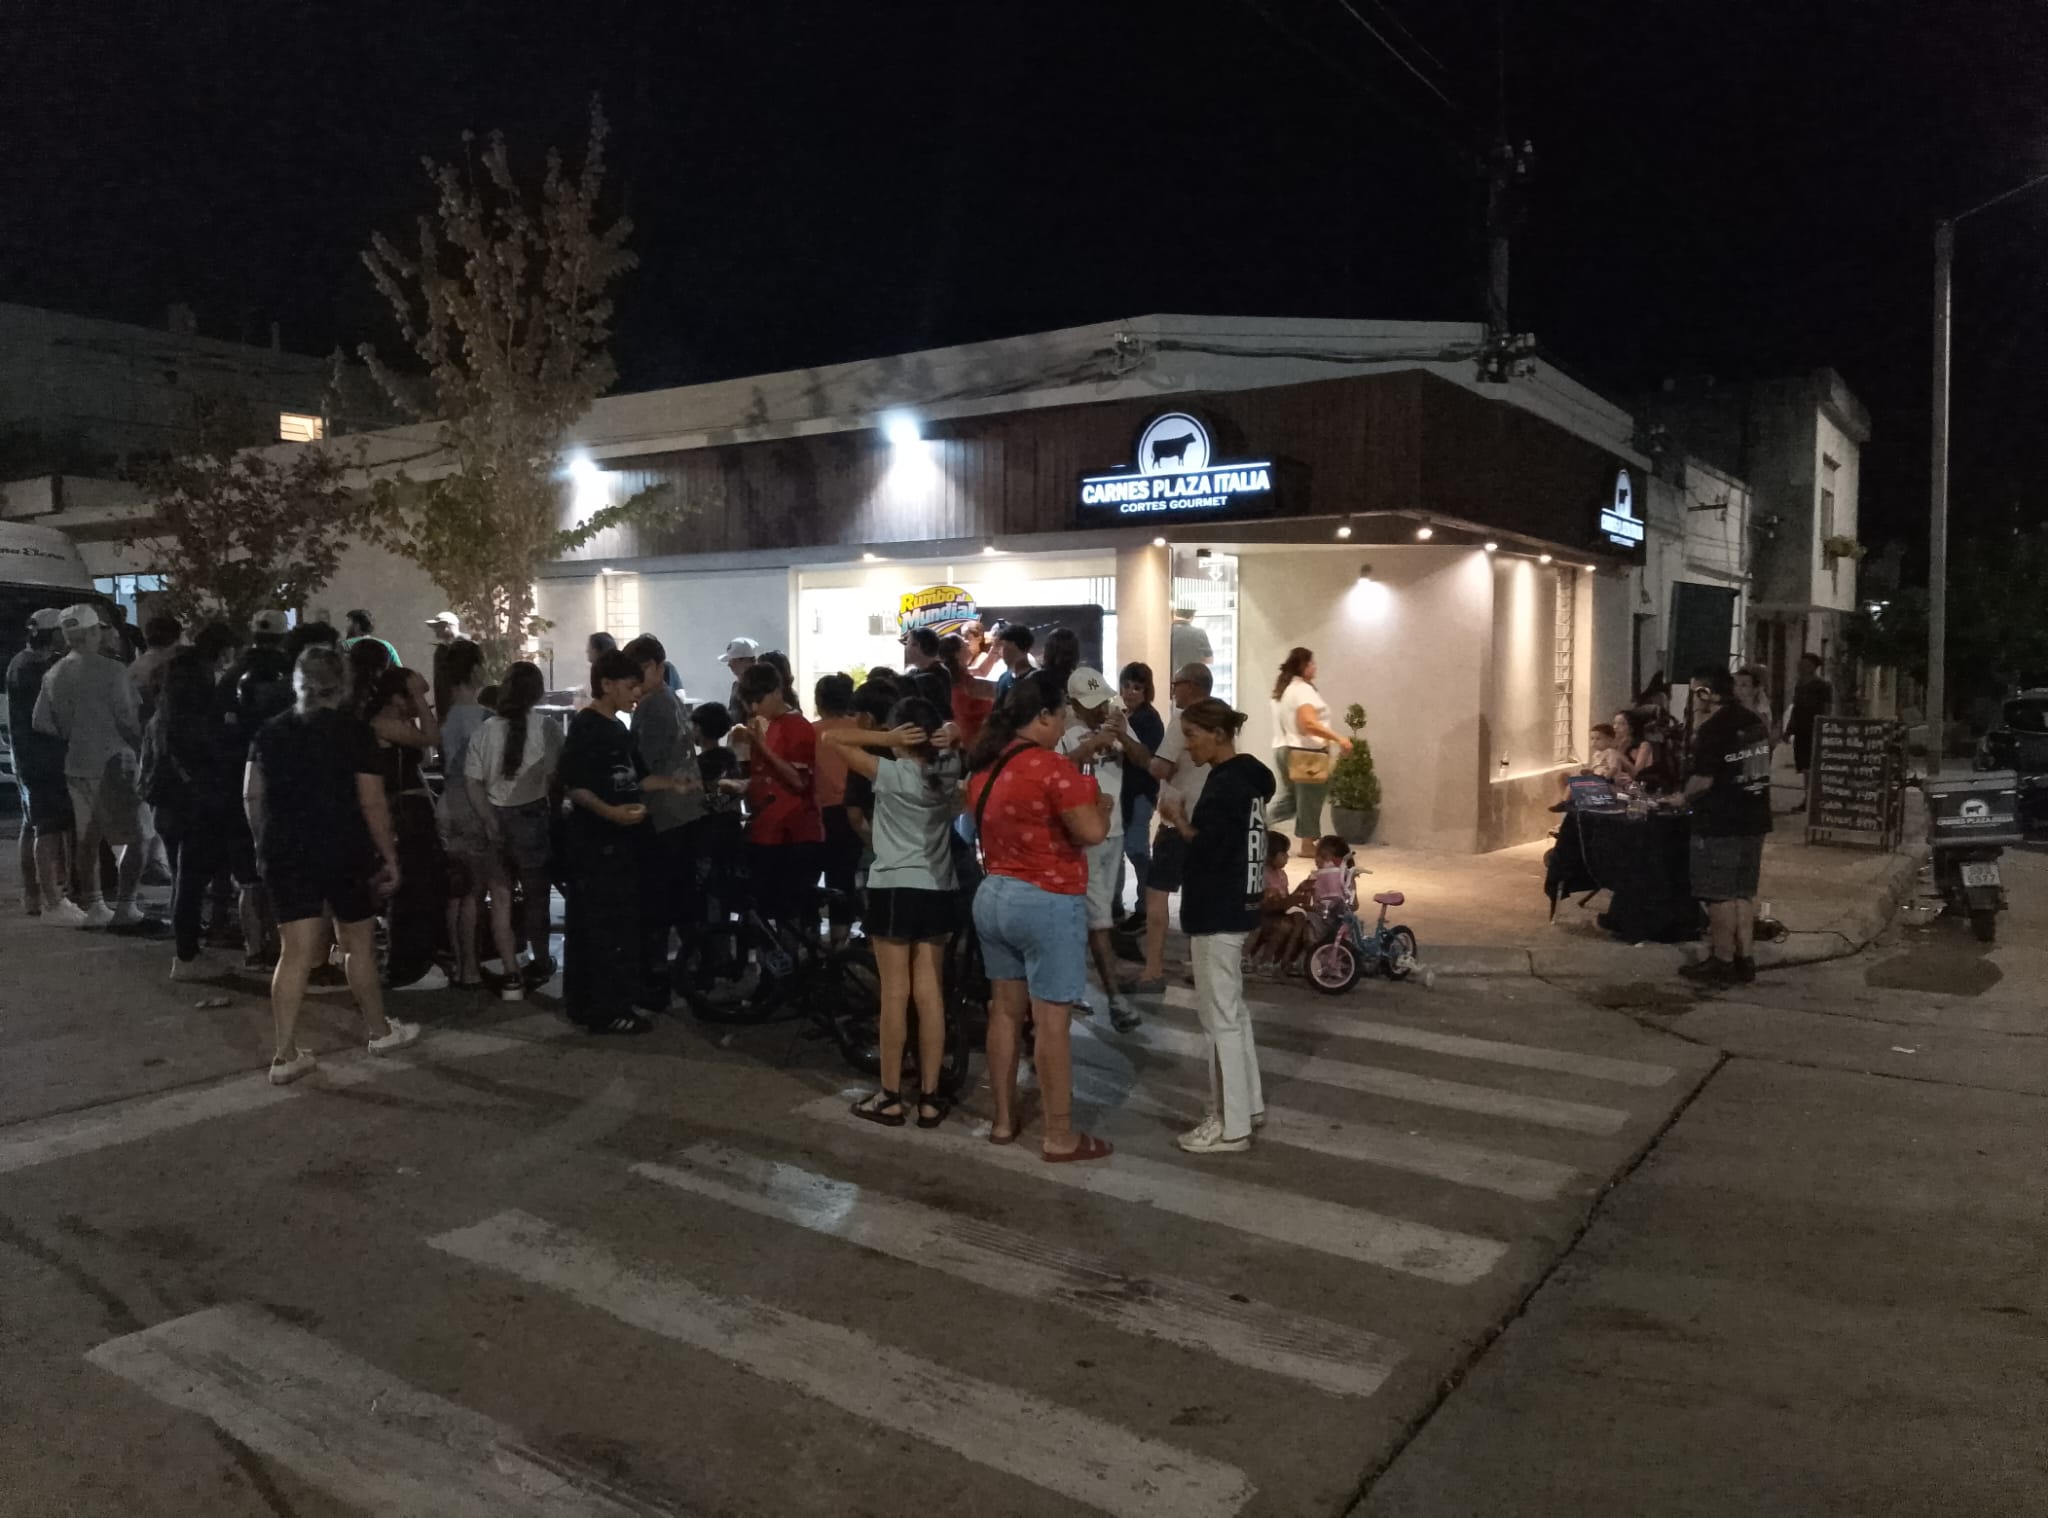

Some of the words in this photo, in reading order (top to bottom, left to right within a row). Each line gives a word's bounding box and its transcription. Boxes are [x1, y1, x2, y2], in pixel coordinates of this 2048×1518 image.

[1083, 479, 1150, 504] CARNES
[1153, 475, 1212, 498] PLAZA
[1214, 470, 1271, 493] ITALIA
[1120, 500, 1167, 513] CORTES
[1169, 496, 1228, 510] GOURMET
[900, 588, 956, 613] Rumbo
